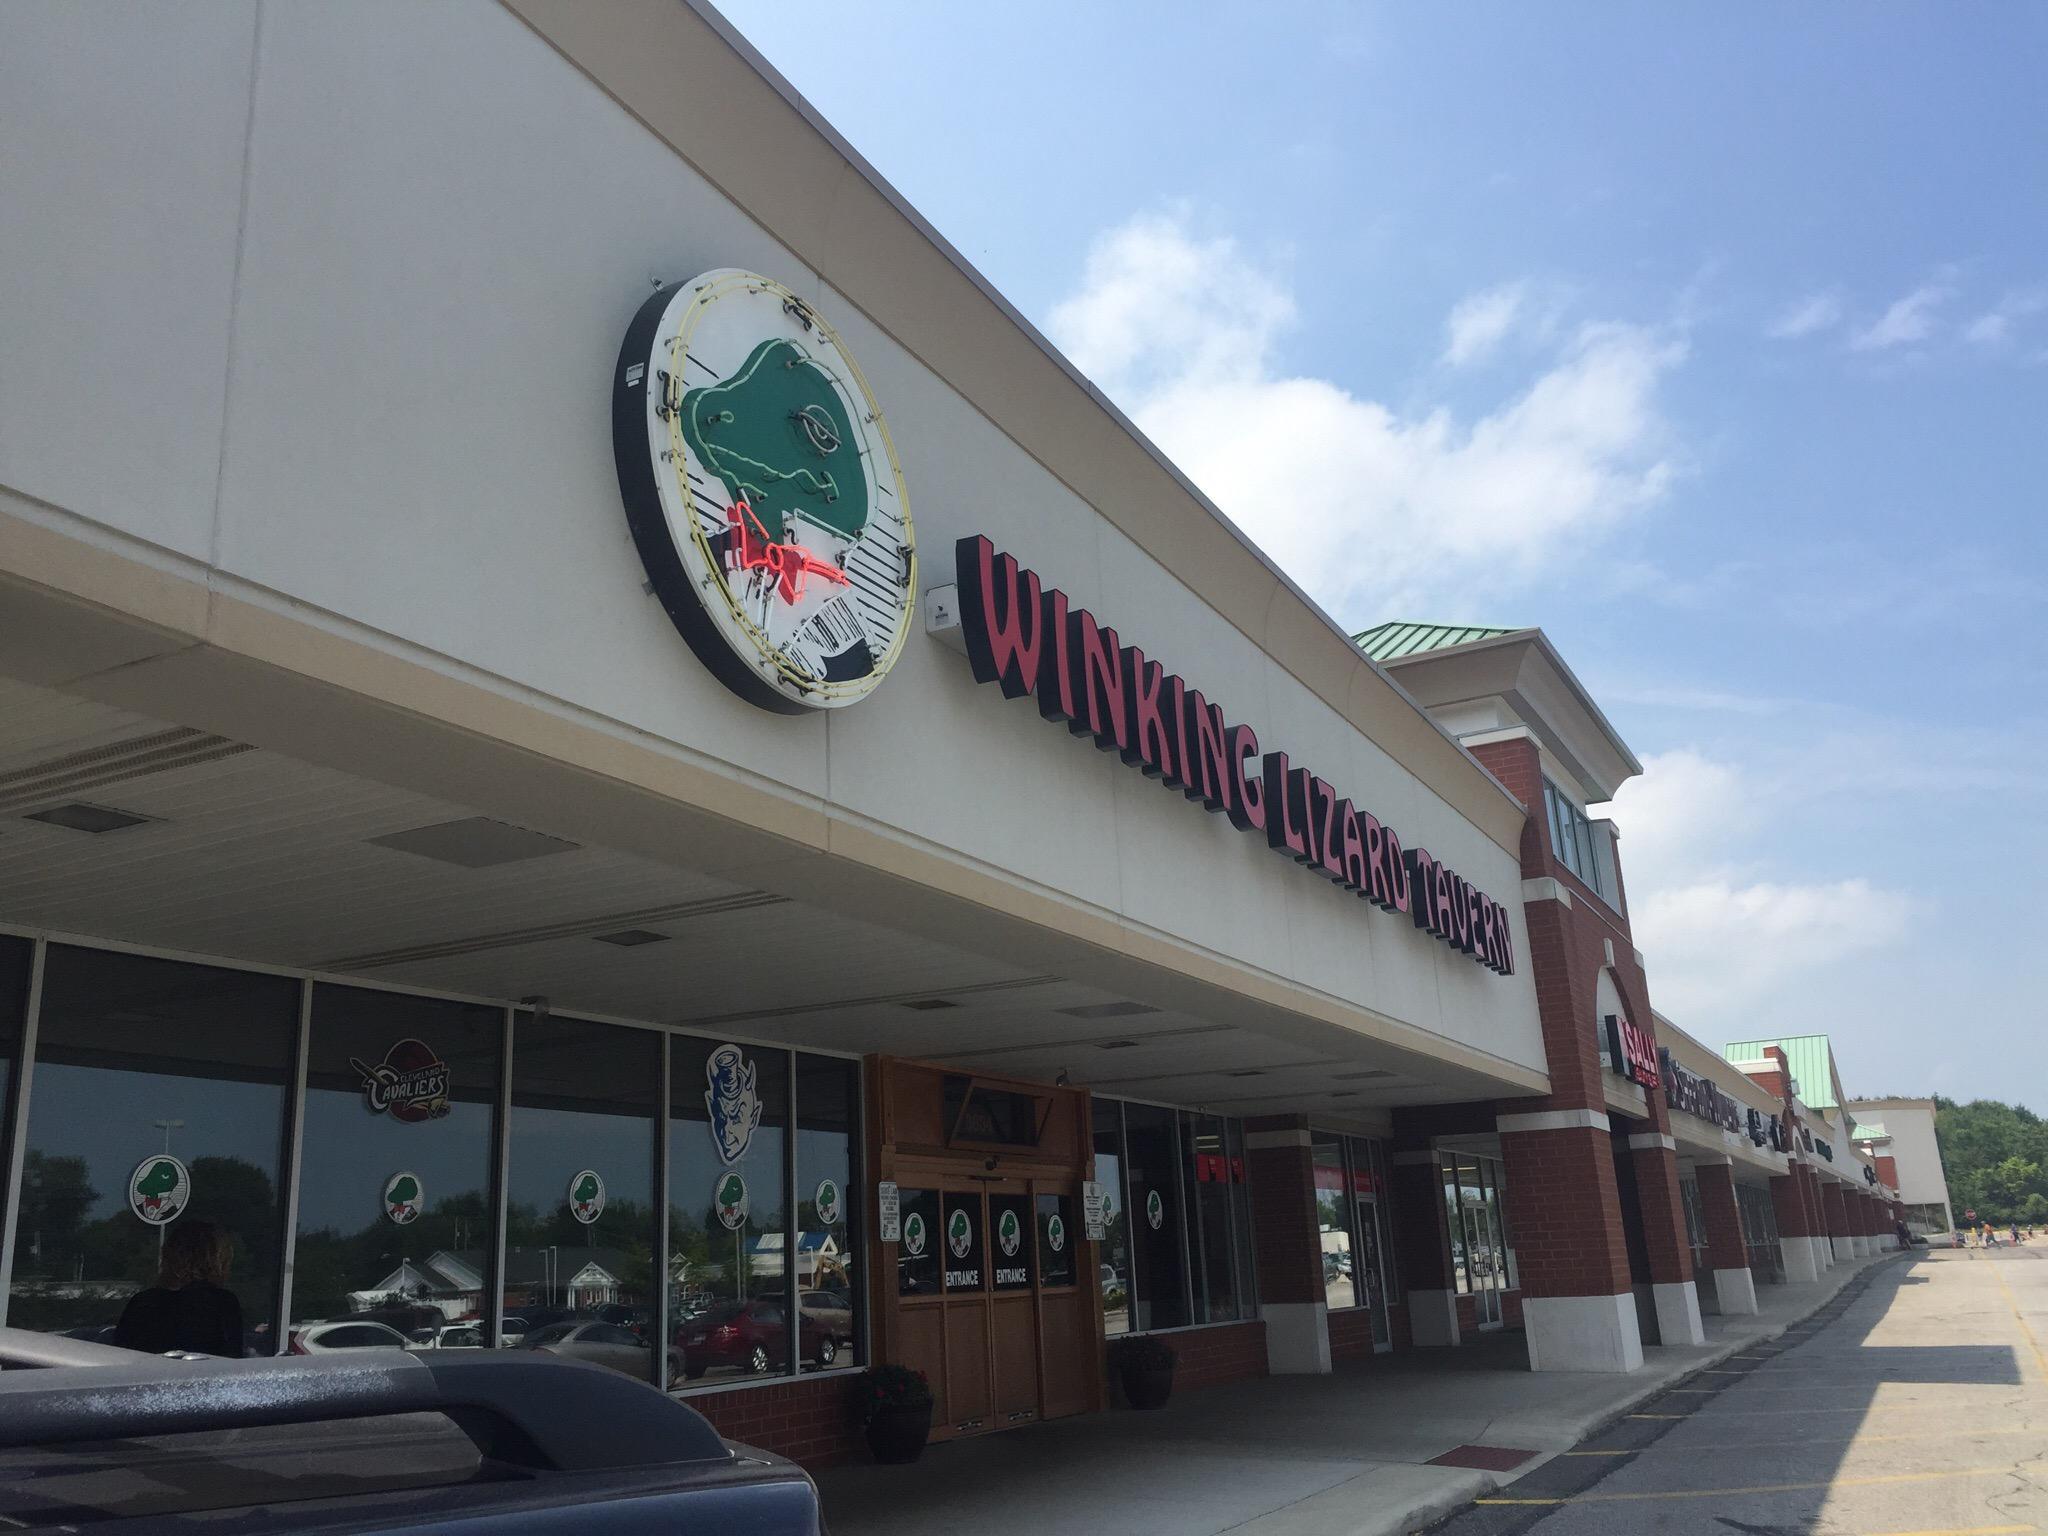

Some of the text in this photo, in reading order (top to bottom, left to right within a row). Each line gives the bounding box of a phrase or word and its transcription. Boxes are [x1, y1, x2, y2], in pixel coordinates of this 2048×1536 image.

[972, 533, 1515, 976] WINKING LIZARD TAVERN
[400, 1067, 441, 1083] CLEVELAND
[367, 1069, 445, 1109] CAVALIERS
[945, 1269, 979, 1287] ENTRANCE
[996, 1267, 1027, 1284] ENTRANCE
